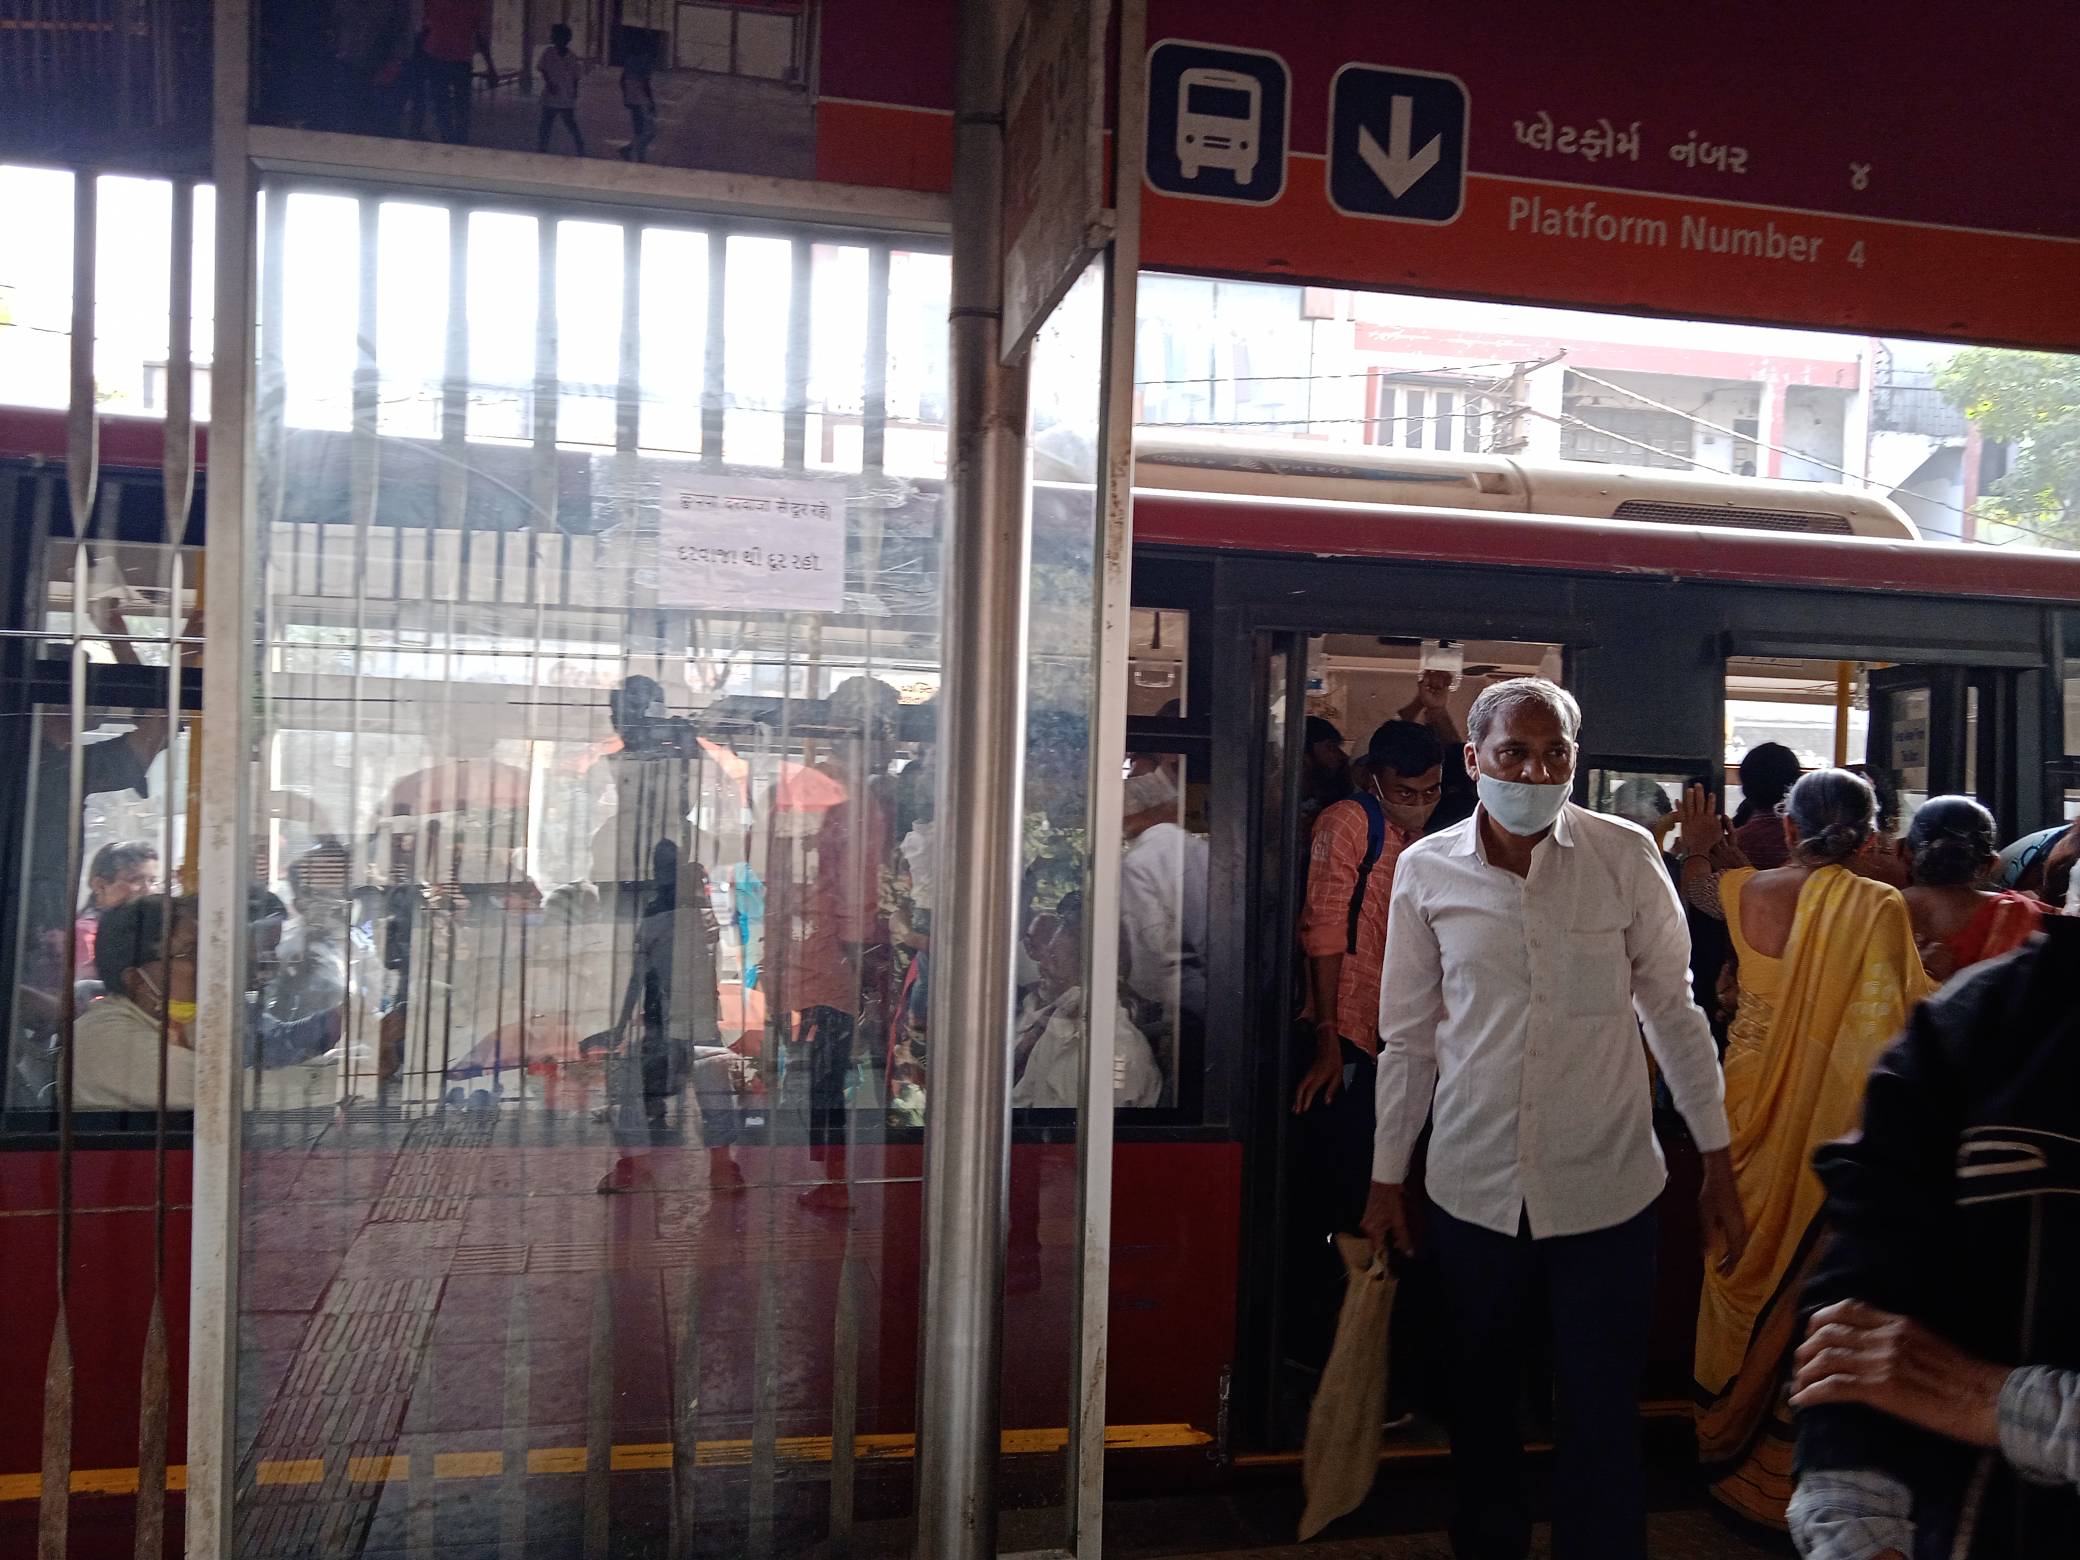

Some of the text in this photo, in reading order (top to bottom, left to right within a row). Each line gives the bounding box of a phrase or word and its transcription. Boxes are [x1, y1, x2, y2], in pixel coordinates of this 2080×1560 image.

[1513, 111, 1872, 190] પ્લેટફોર્મ નંબર ૪
[1508, 195, 1867, 269] Platform Number 4
